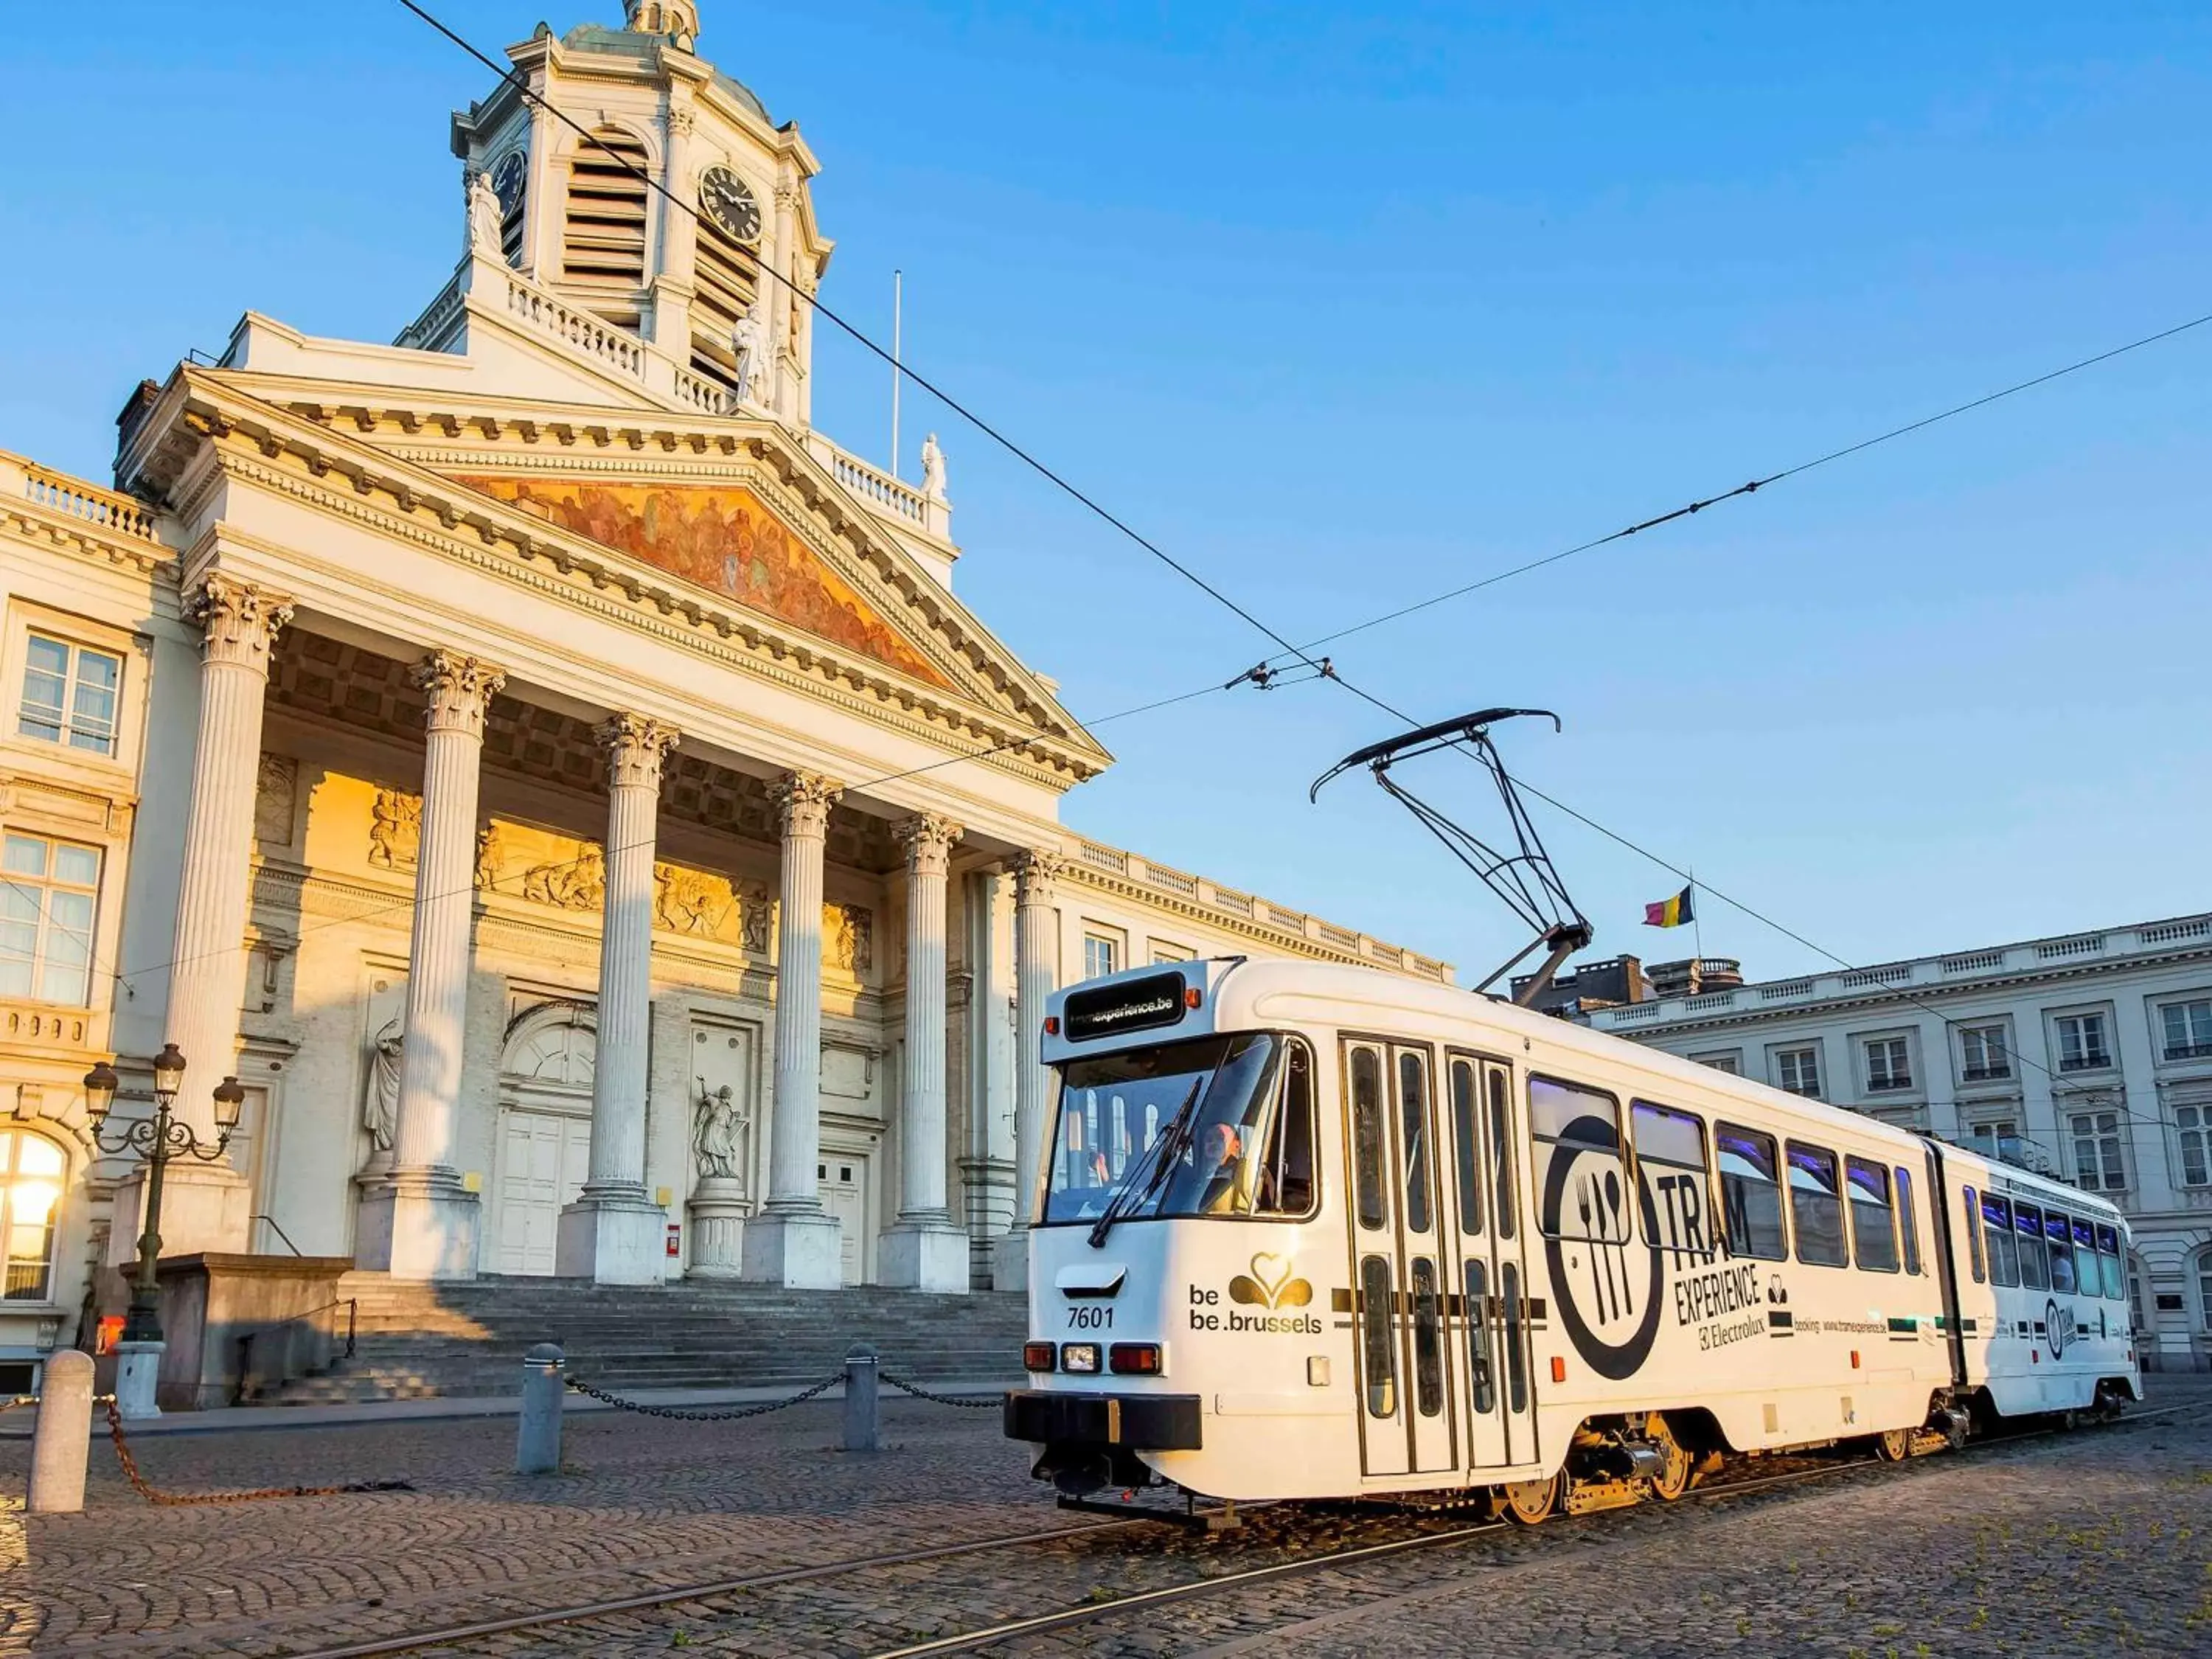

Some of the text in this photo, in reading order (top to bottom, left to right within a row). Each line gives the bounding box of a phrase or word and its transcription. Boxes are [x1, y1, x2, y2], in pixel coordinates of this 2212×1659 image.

[1657, 1174, 1753, 1271] TRAM
[1189, 1284, 1219, 1305] be
[1674, 1263, 1761, 1326] EXPERIENCE
[1068, 1307, 1114, 1329] 7601
[1711, 1314, 1766, 1349] Electrolux
